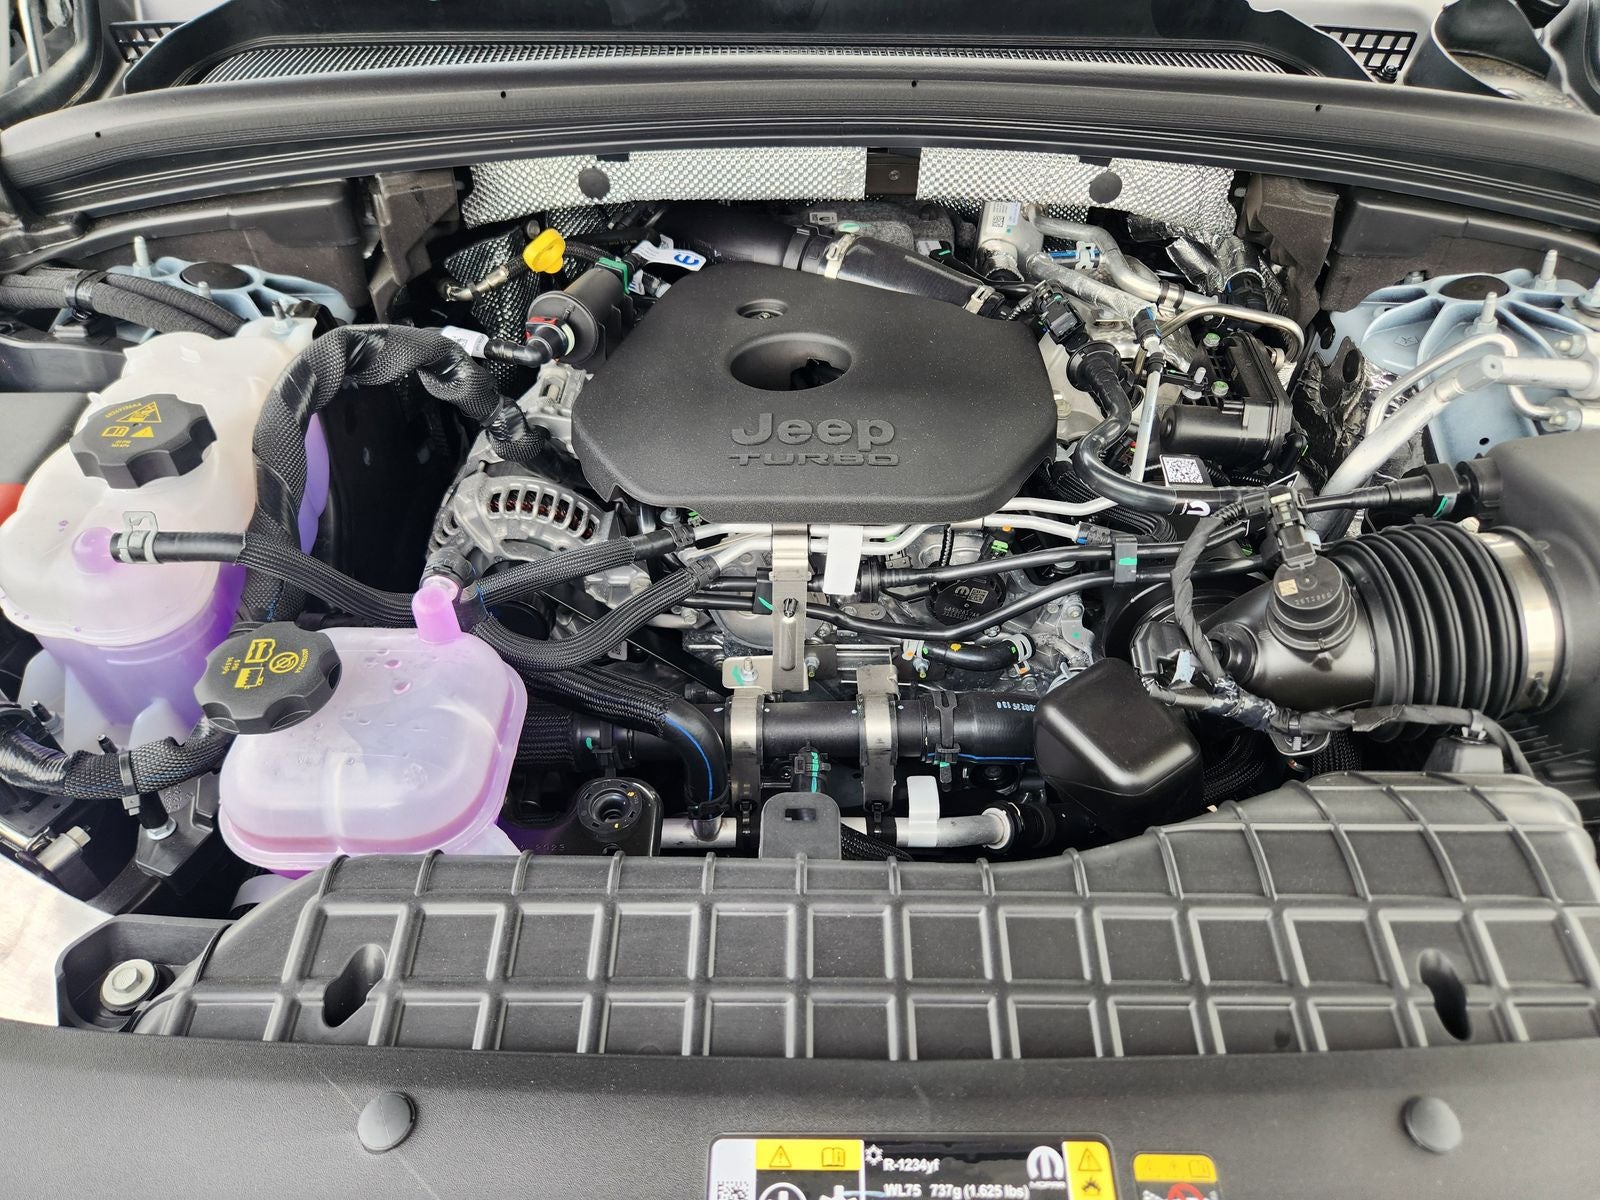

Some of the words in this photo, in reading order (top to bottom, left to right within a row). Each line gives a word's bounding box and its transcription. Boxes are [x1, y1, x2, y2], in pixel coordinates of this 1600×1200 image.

[731, 413, 895, 453] Jeep
[727, 452, 899, 467] TURBO
[883, 1157, 941, 1175] R-1234yf
[883, 1184, 922, 1198] WL75
[929, 1184, 962, 1200] 737g
[963, 1184, 1004, 1200] (1.625
[1005, 1184, 1031, 1200] lbs)
